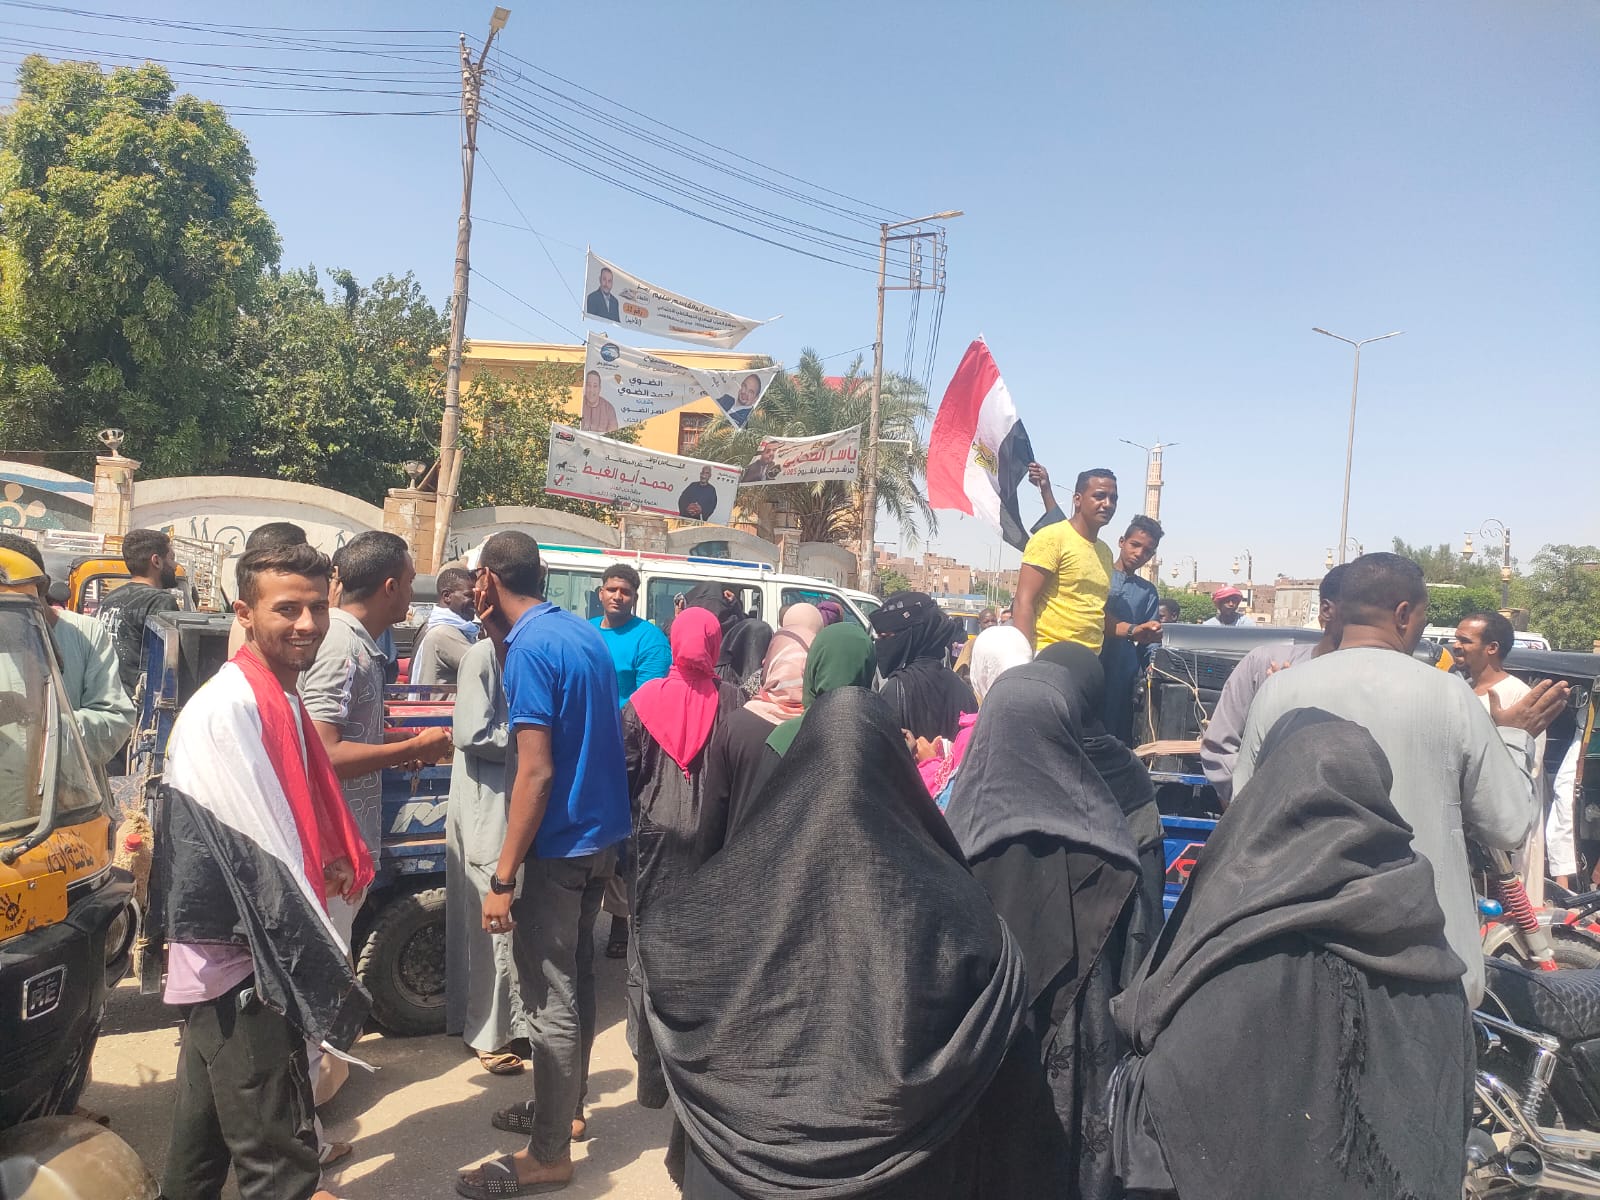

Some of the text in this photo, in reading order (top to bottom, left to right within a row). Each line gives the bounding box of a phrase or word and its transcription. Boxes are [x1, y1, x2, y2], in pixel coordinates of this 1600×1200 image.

[629, 377, 663, 387] الضوي
[617, 387, 649, 397] الضوي
[826, 446, 858, 465] ياسر
[581, 462, 619, 480] الغيط
[834, 465, 855, 474] مرشح
[619, 470, 640, 486] أبو
[639, 476, 674, 492] محمد
[31, 982, 58, 1010] RE
